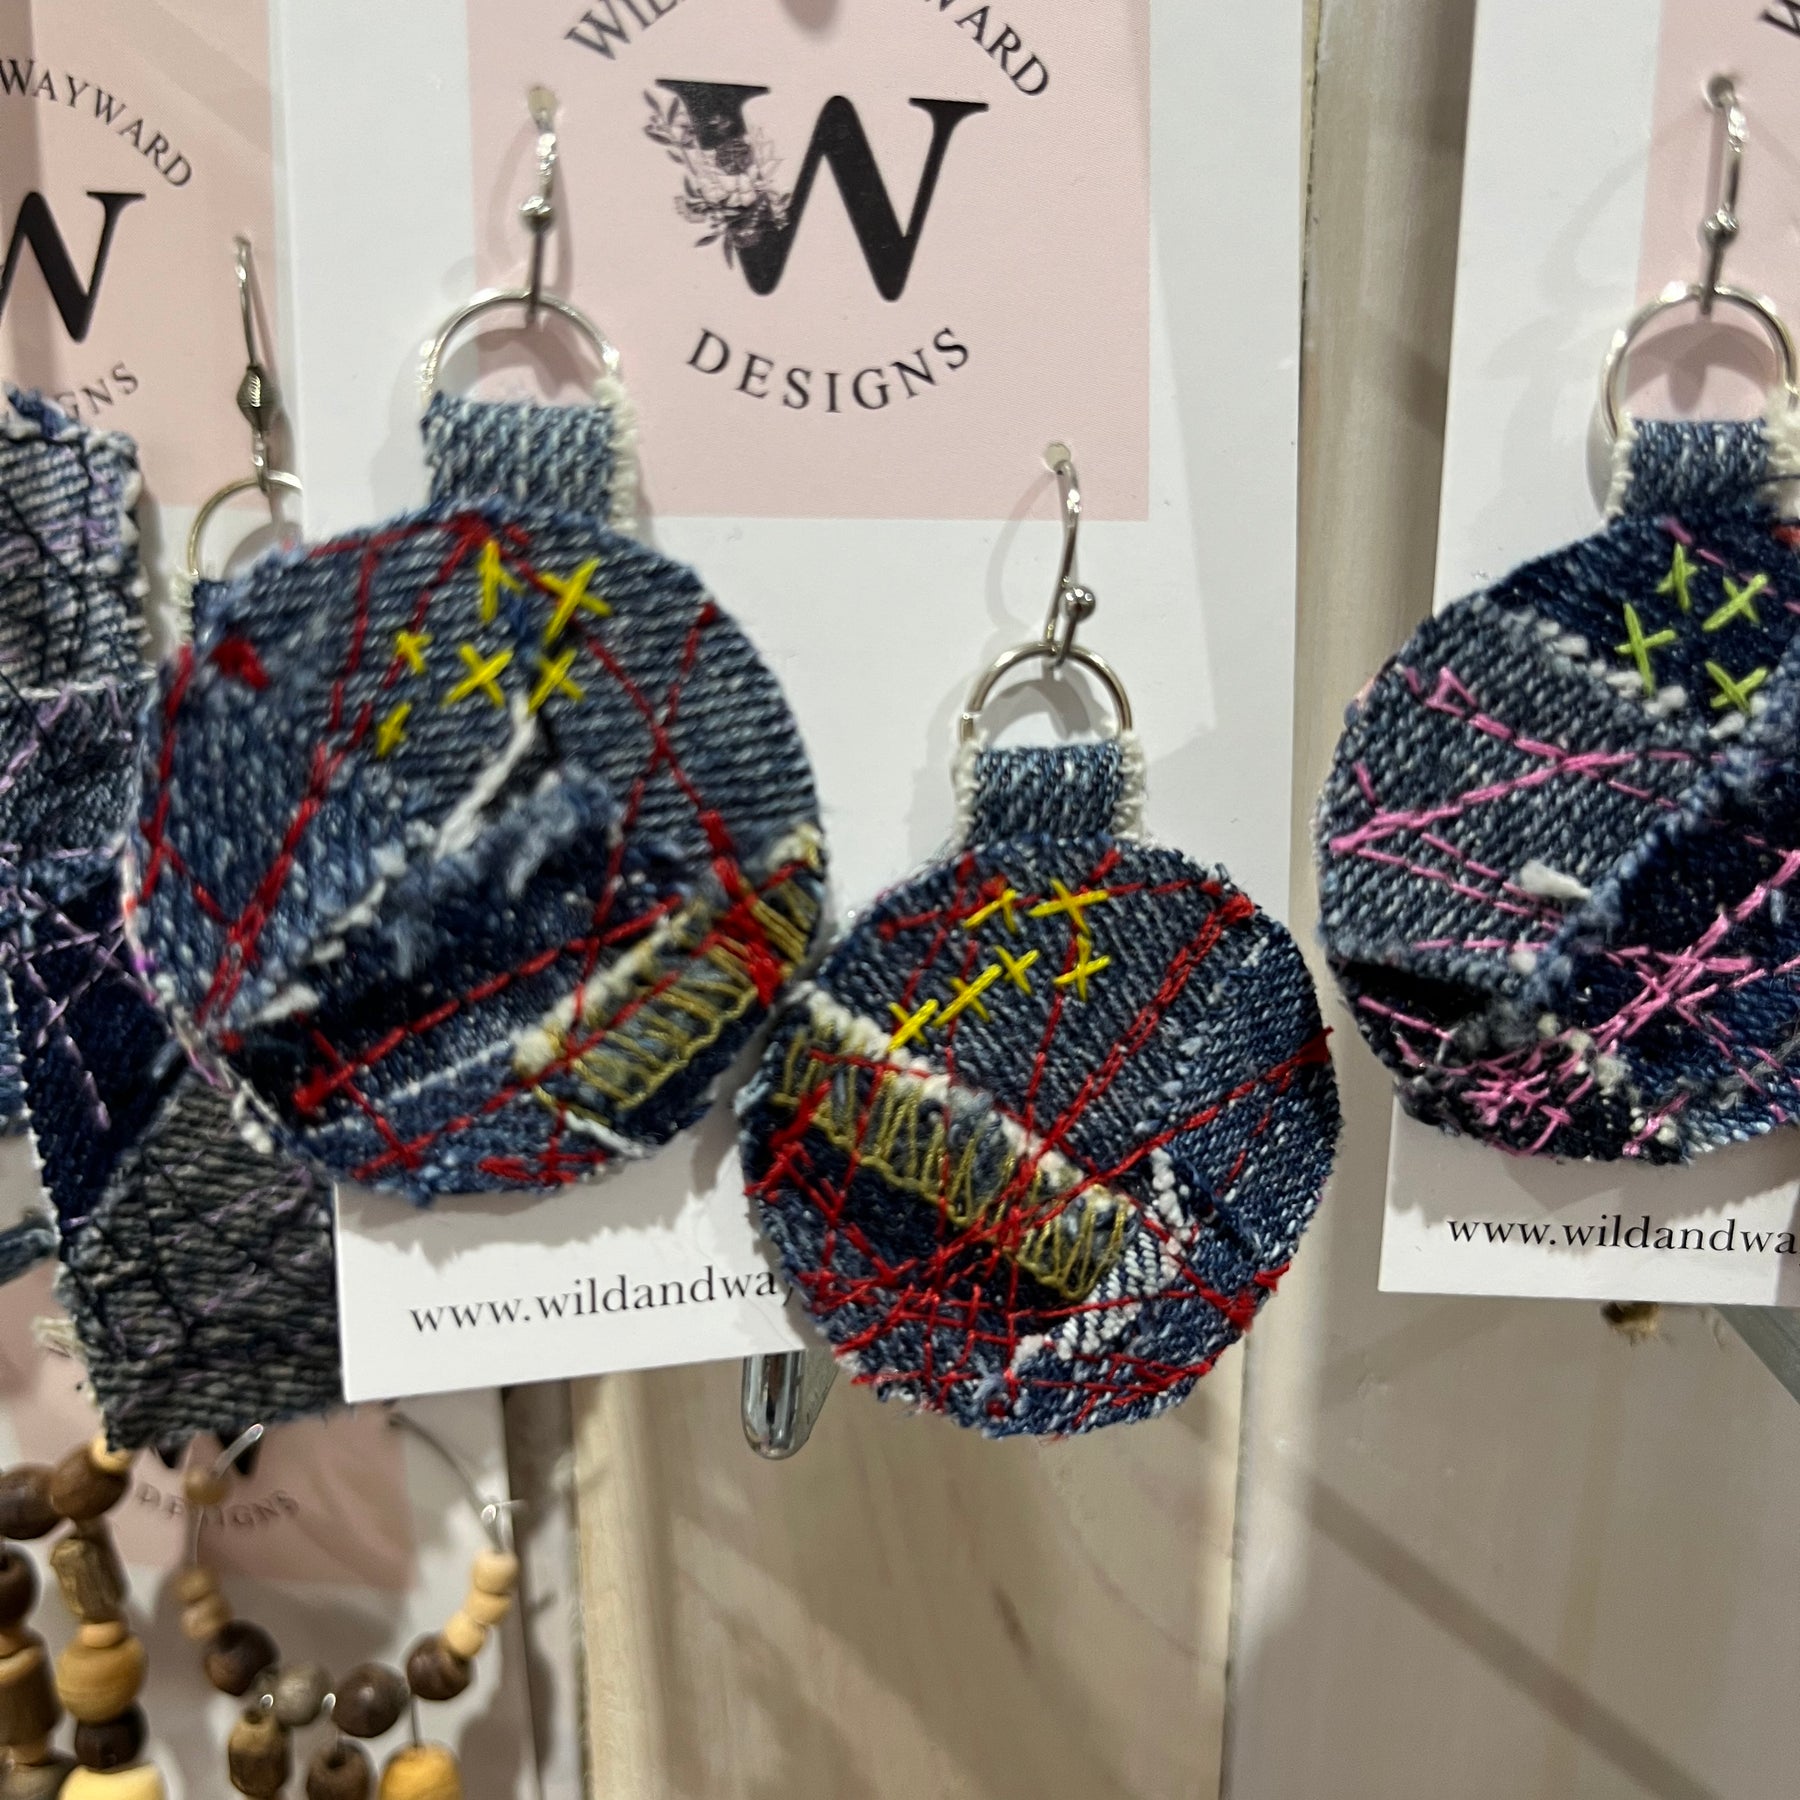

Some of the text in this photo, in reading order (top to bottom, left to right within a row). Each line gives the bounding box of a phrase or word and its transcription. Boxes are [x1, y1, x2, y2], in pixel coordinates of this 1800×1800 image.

[939, 0, 1049, 96] ARD
[0, 59, 192, 186] WAYWARD
[686, 327, 970, 414] DESIGNS
[1447, 1213, 1800, 1256] www.wildandwa
